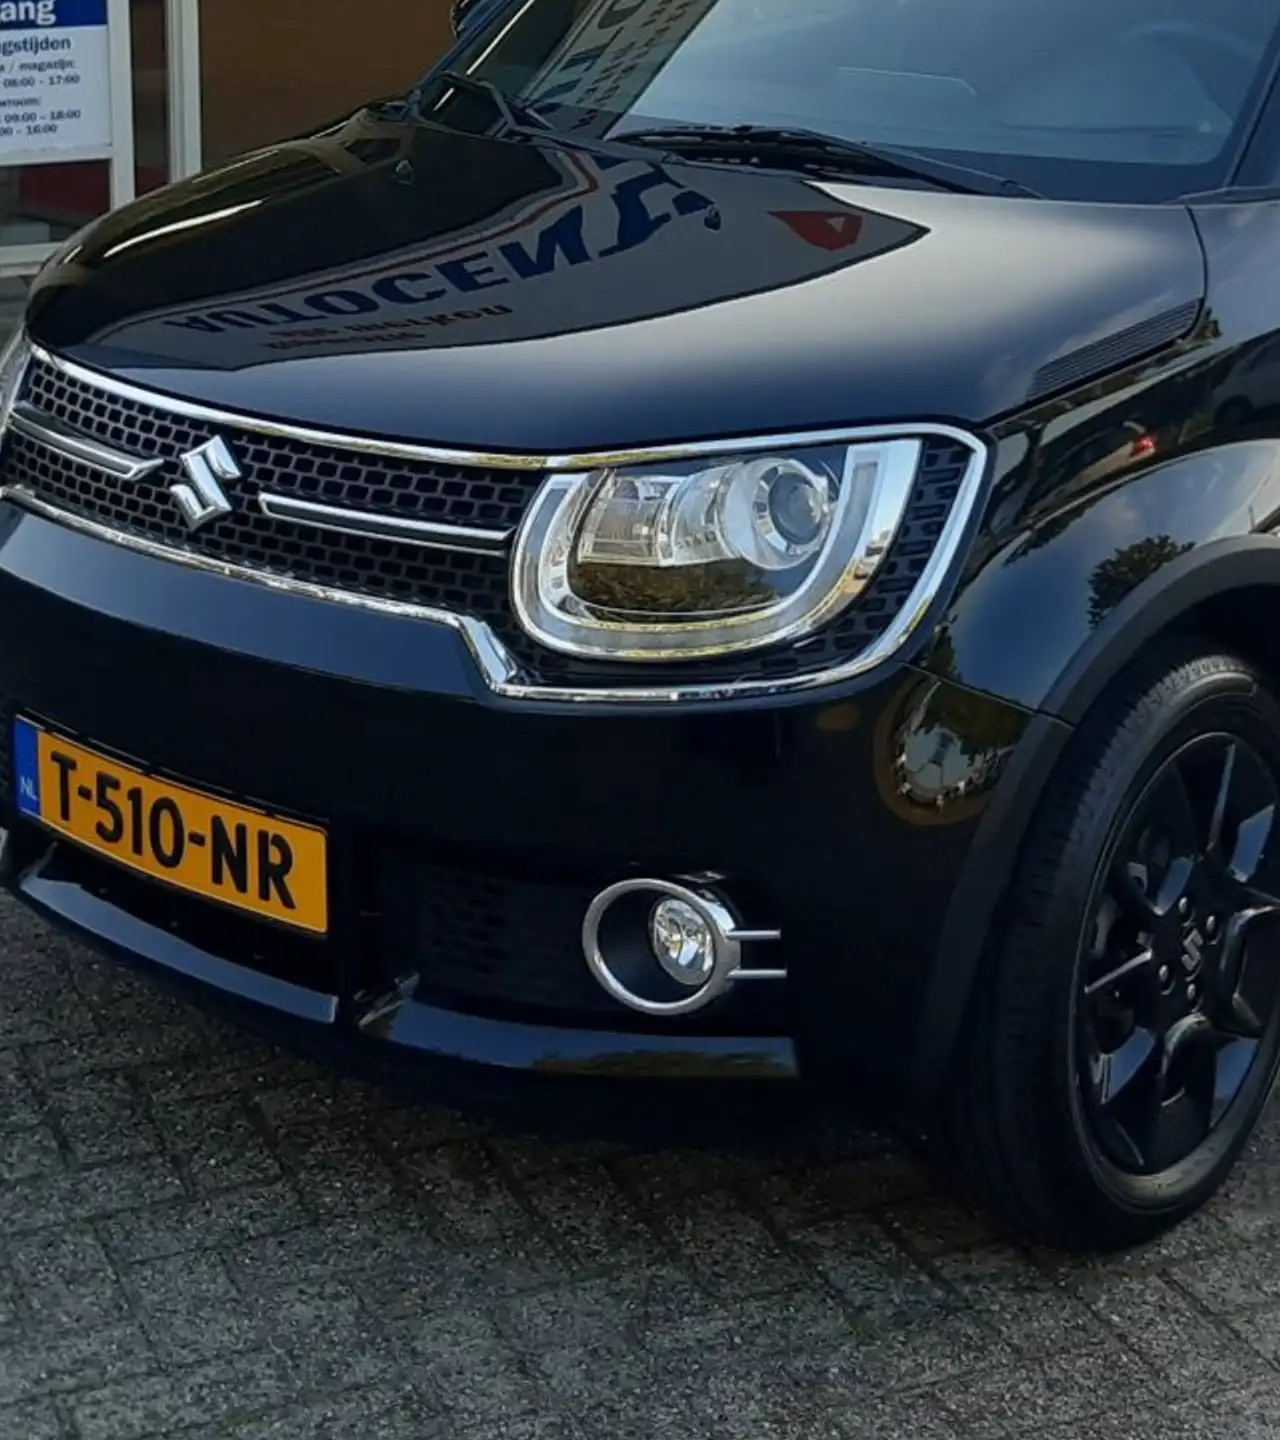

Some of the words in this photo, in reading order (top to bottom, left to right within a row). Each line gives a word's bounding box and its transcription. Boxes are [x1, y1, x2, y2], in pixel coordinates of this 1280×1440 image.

[48, 74, 81, 86] 17:00
[20, 775, 38, 802] NL
[50, 749, 297, 910] T-510-NR
